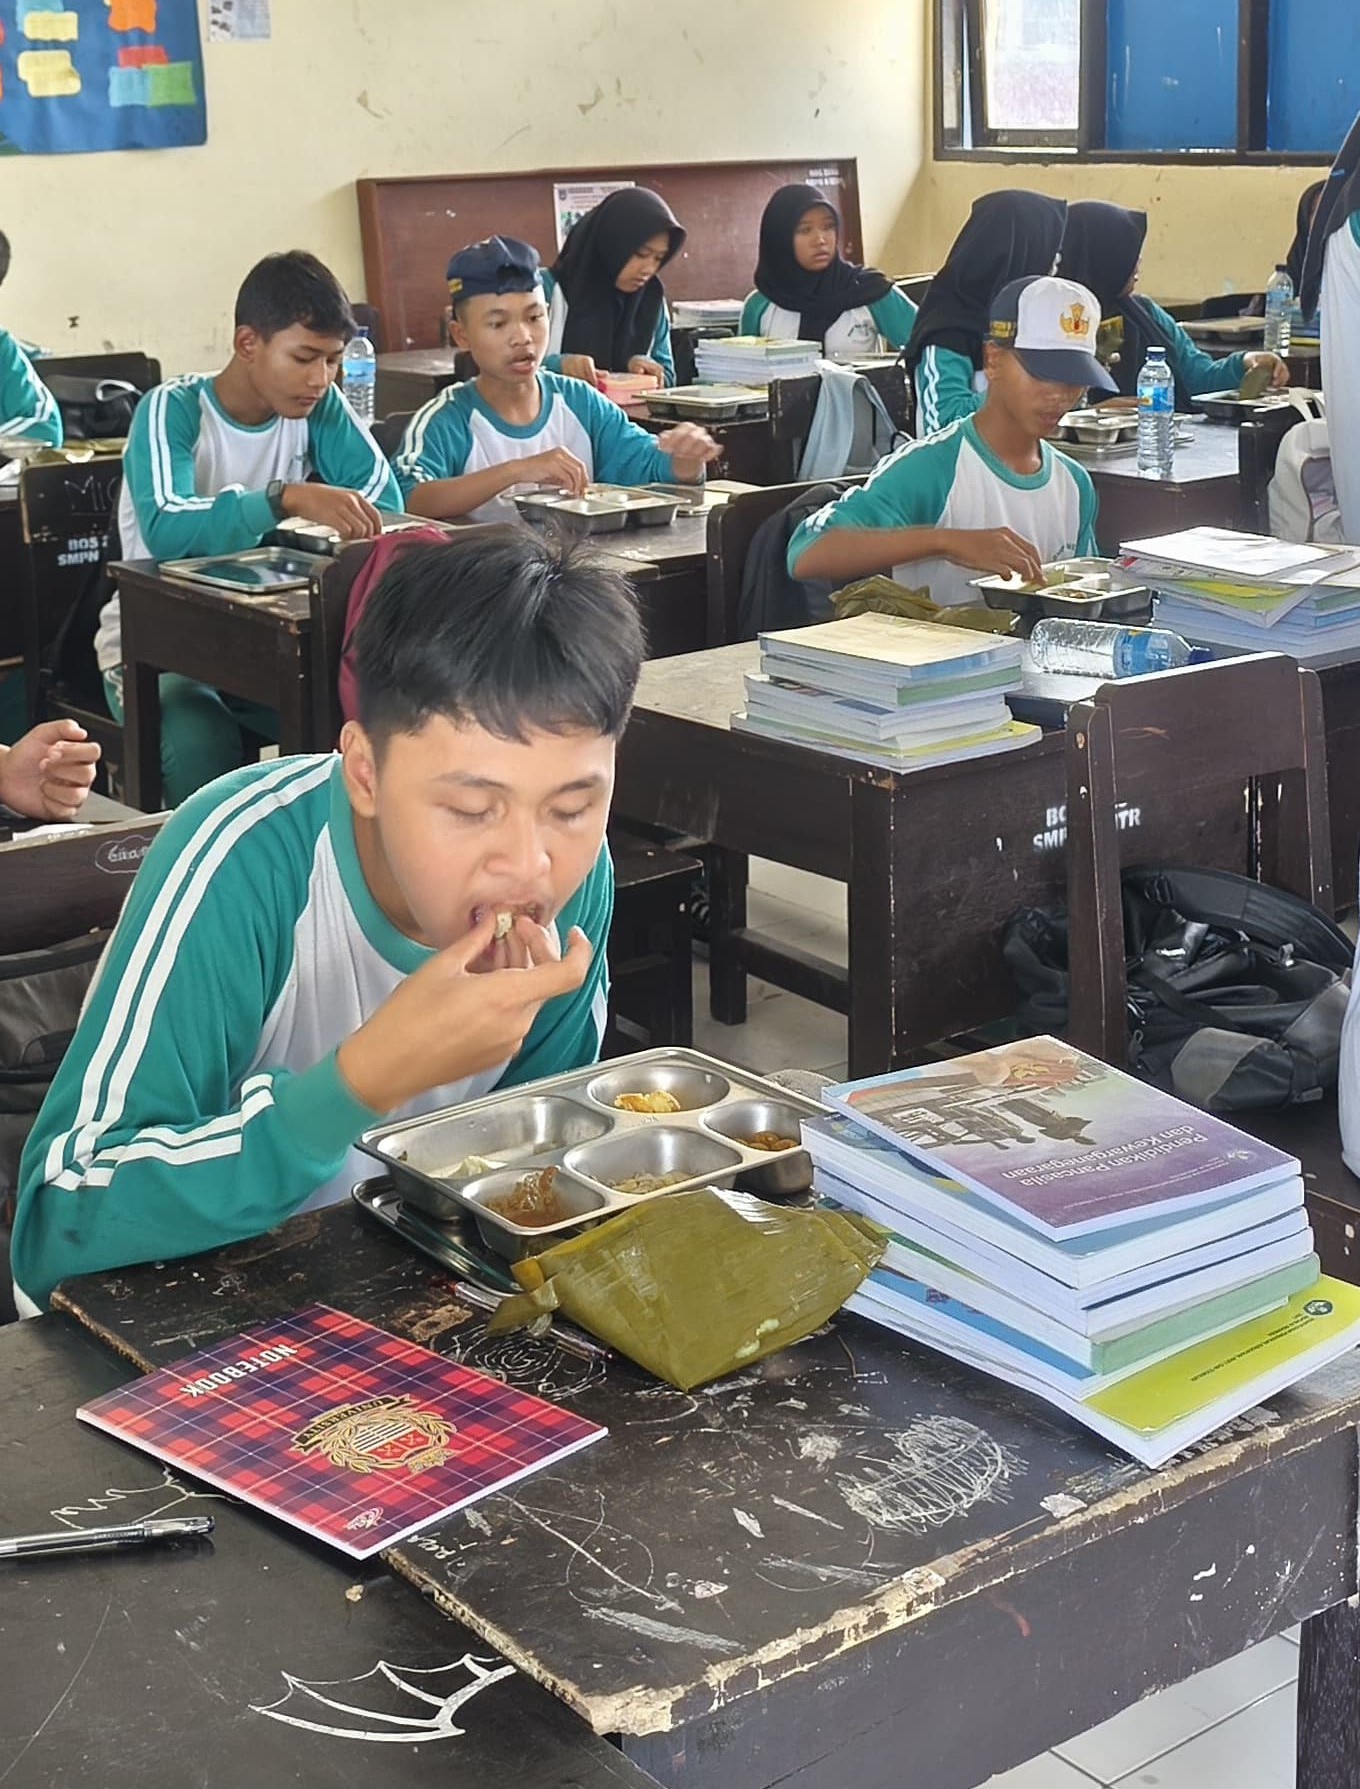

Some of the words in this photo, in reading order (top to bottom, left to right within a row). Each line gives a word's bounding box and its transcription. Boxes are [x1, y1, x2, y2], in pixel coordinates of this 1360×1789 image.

[57, 549, 100, 566] SMPN
[68, 536, 99, 550] BOS
[1032, 827, 1068, 851] SMP
[1115, 808, 1141, 831] TR
[1045, 805, 1068, 828] BO
[1159, 1123, 1195, 1141] dan
[1001, 1136, 1162, 1179] Kewarganegaraan
[1109, 1132, 1209, 1167] Pendidikan
[1019, 1162, 1111, 1187] Pancasila
[180, 1343, 298, 1398] NOTEBOOK
[304, 1399, 385, 1439] UNIVERSITY
